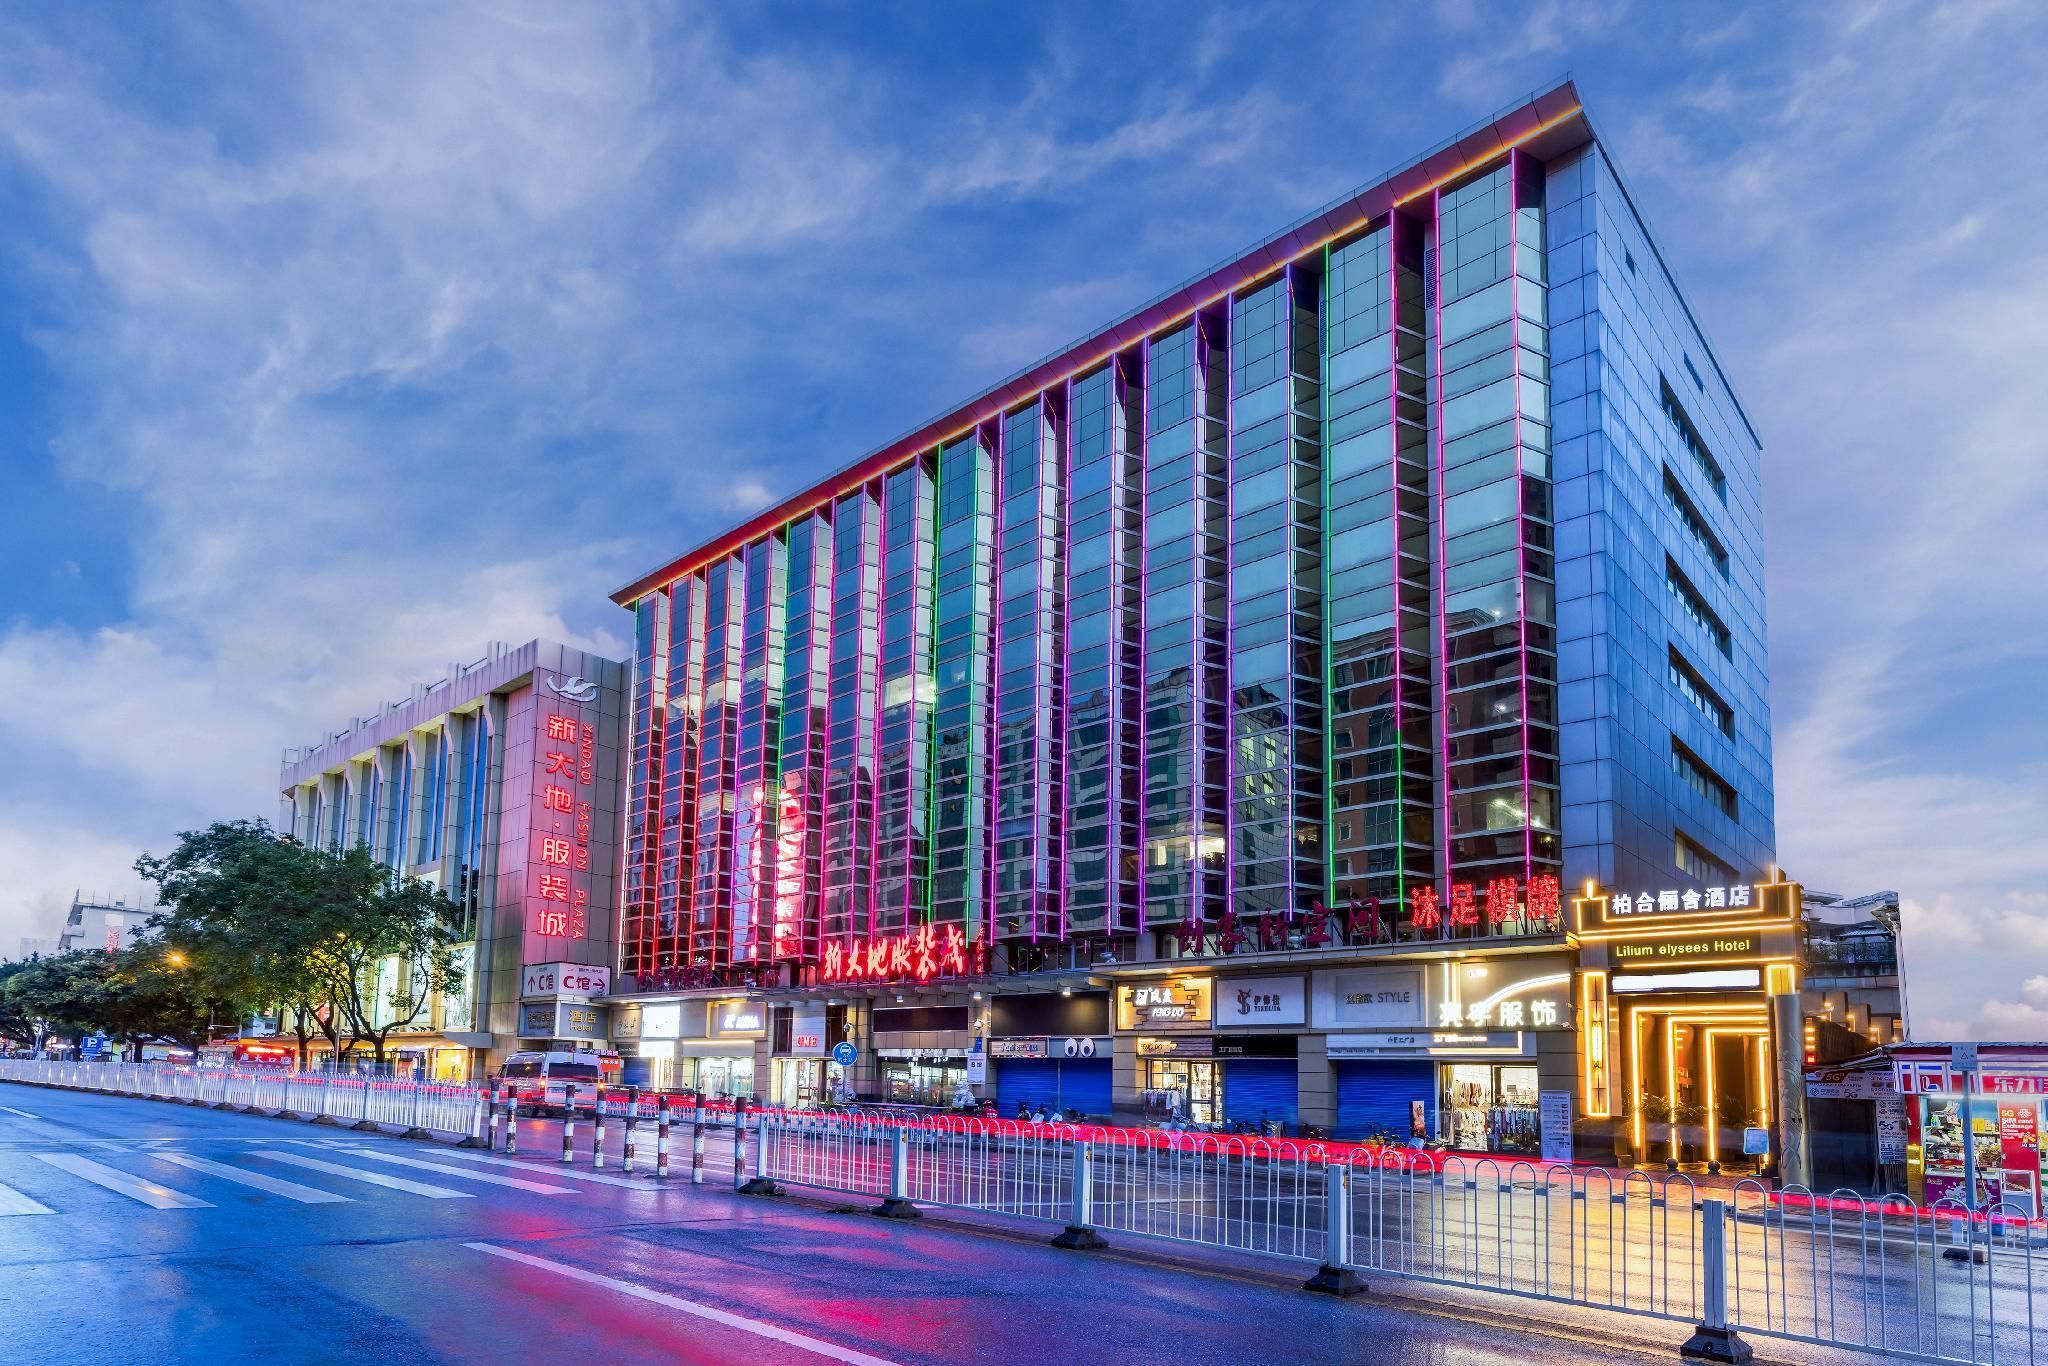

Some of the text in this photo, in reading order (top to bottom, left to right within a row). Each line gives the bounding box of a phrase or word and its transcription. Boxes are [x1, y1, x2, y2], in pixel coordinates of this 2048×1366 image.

[537, 715, 577, 937] 新大地·服装城
[572, 723, 593, 939] XINDADI FASHION PLAZA
[1616, 940, 1750, 957] Lilium elysees Hotel
[563, 976, 591, 991] C馆
[1377, 992, 1410, 1003] STYLE
[568, 1009, 597, 1024] 酒店
[570, 1023, 593, 1032] Hotel
[87, 1038, 98, 1047] P
